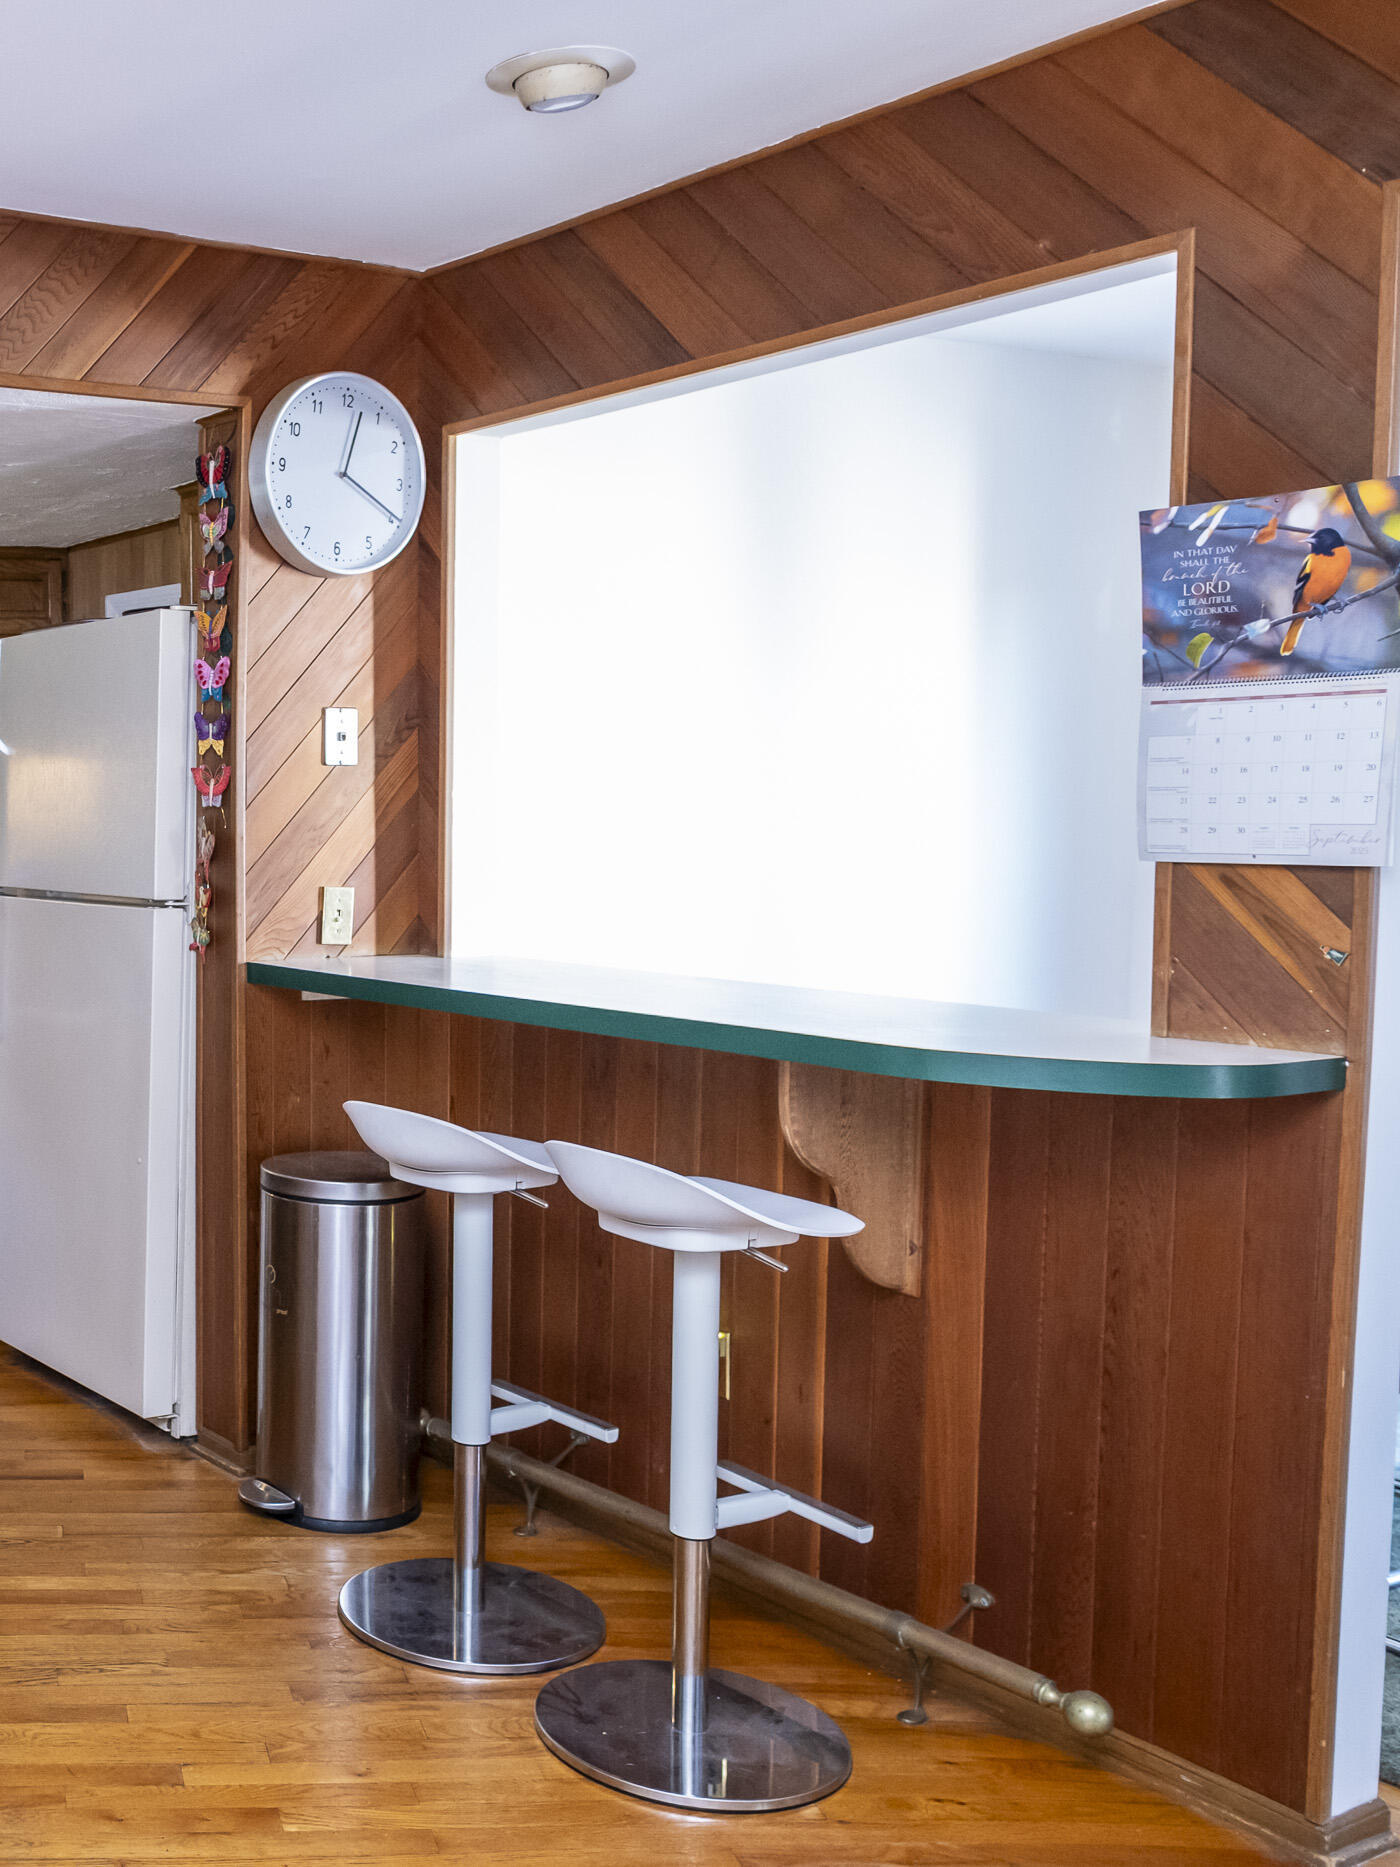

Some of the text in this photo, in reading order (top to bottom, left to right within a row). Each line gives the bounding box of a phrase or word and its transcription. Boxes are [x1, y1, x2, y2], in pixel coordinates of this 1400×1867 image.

[312, 400, 323, 414] 11
[342, 394, 354, 408] 12
[375, 412, 381, 425] 1
[289, 422, 301, 437] 10
[391, 441, 398, 454] 2
[278, 457, 286, 471] 9
[396, 478, 403, 492] 3
[285, 494, 292, 508] 8
[303, 526, 311, 539] 7
[333, 541, 341, 556] 6
[365, 536, 373, 549] 5
[1187, 547, 1213, 556] THAT
[1216, 545, 1238, 554] DAY
[1179, 556, 1231, 567] SHALL THE
[1211, 566, 1223, 583] of
[1224, 561, 1249, 577] the
[1183, 580, 1231, 596] LORD
[1177, 595, 1233, 607] BE BEAUTIFUL
[1171, 608, 1192, 617] AND
[1304, 733, 1313, 741] 11
[1336, 732, 1346, 740] 12
[1370, 731, 1379, 739] 13
[1181, 767, 1189, 775] 14
[1210, 766, 1218, 774] 15
[1239, 766, 1248, 774] 16
[1270, 765, 1279, 773] 17
[1333, 764, 1343, 772] 19
[1365, 763, 1377, 771] 20
[1237, 796, 1247, 804] 23
[1267, 796, 1277, 804] 24
[1298, 796, 1308, 804] 25
[1330, 796, 1341, 804] 26
[1363, 795, 1374, 803] 27
[1208, 826, 1217, 834] 29
